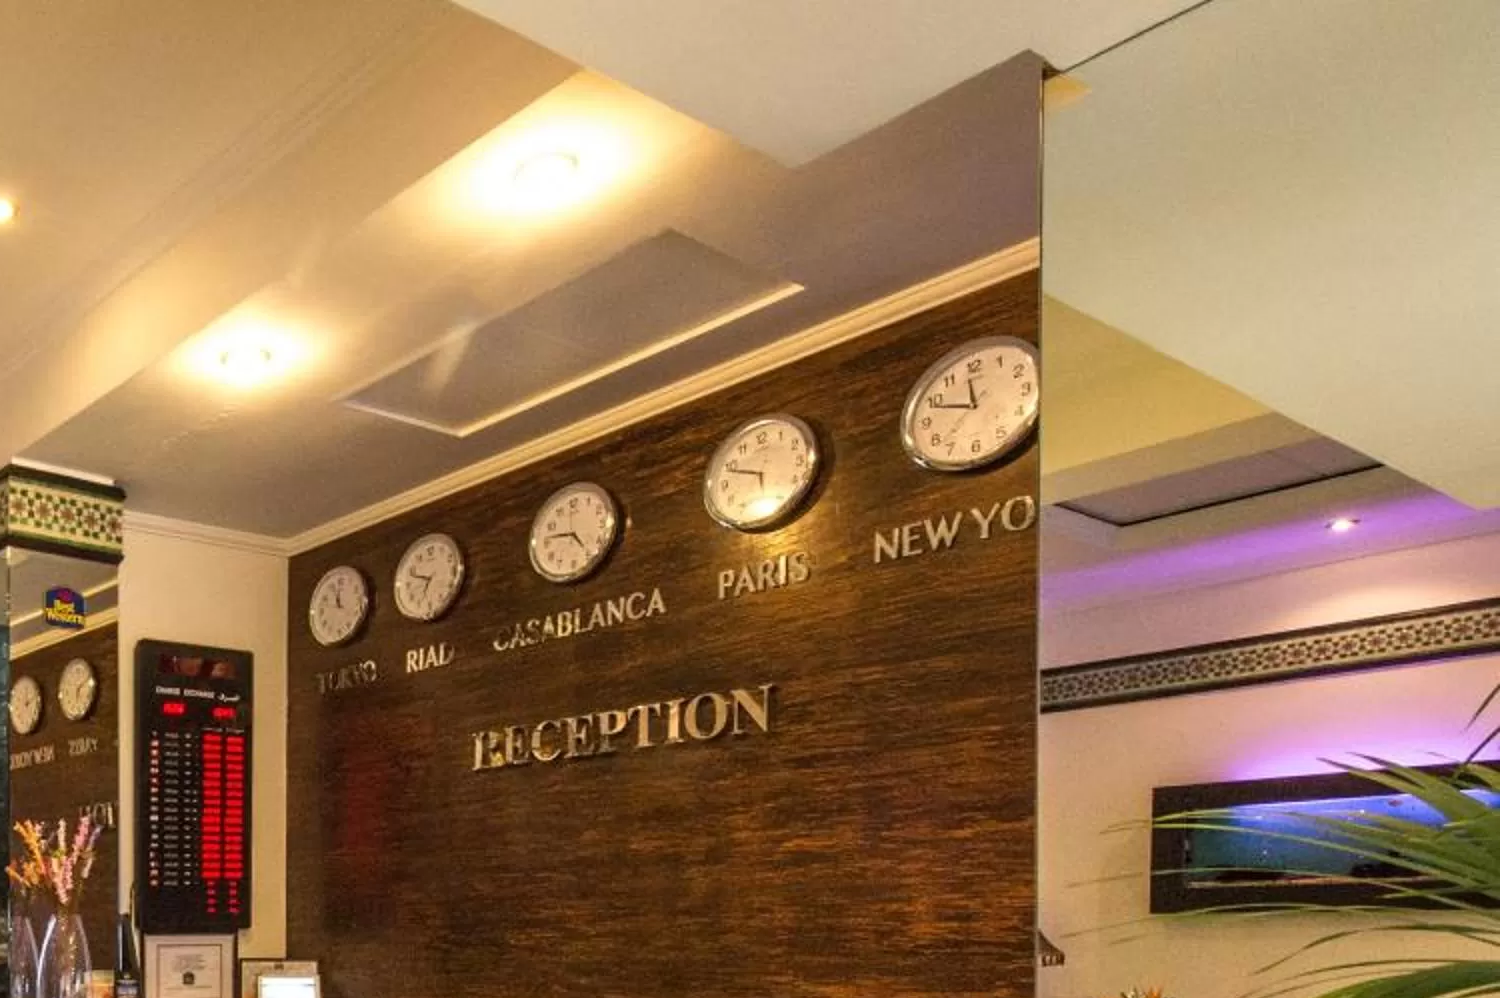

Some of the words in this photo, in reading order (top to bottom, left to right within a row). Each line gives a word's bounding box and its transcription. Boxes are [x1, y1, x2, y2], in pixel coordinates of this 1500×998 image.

[944, 375, 956, 388] 11
[1012, 364, 1025, 379] 2
[873, 511, 963, 564] NEW
[971, 495, 1036, 540] YO
[718, 551, 811, 600] PARIS
[492, 588, 668, 652] CASABLANCA
[406, 642, 456, 674] RIAD
[470, 682, 776, 772] RECEPTION
